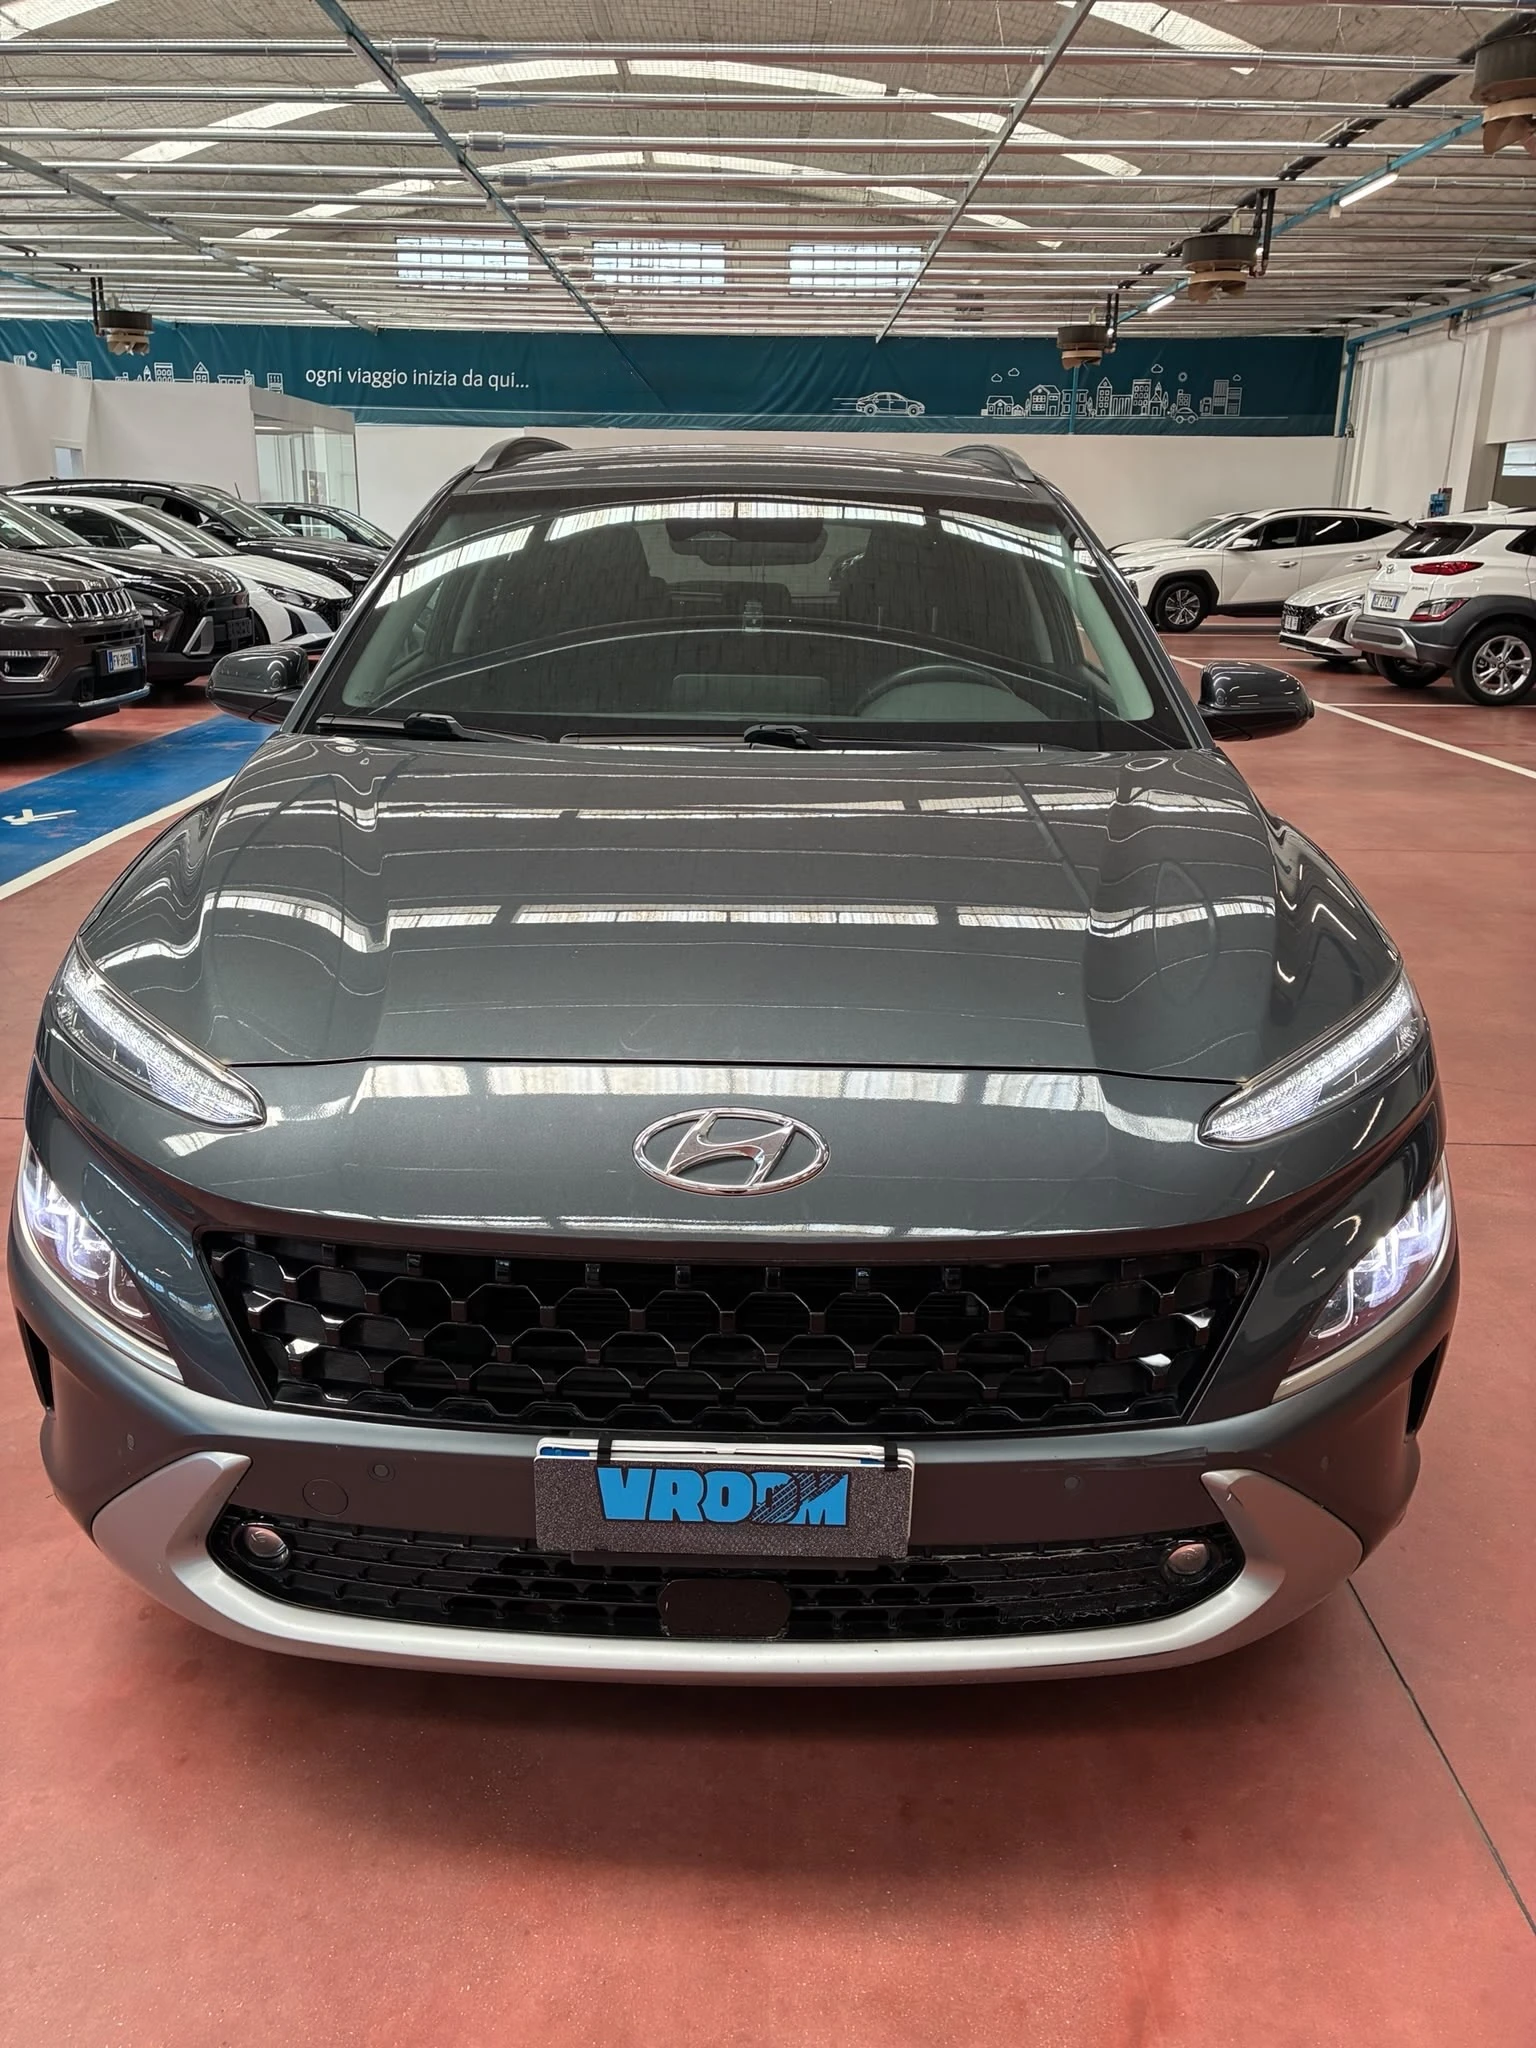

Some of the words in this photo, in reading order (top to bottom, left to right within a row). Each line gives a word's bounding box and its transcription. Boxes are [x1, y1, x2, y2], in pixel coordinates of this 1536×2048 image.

[305, 367, 342, 387] ogni
[347, 368, 408, 389] viaggio
[413, 368, 457, 386] inizia
[462, 368, 483, 387] da
[488, 371, 530, 391] qui...
[596, 1466, 850, 1527] VROOM
